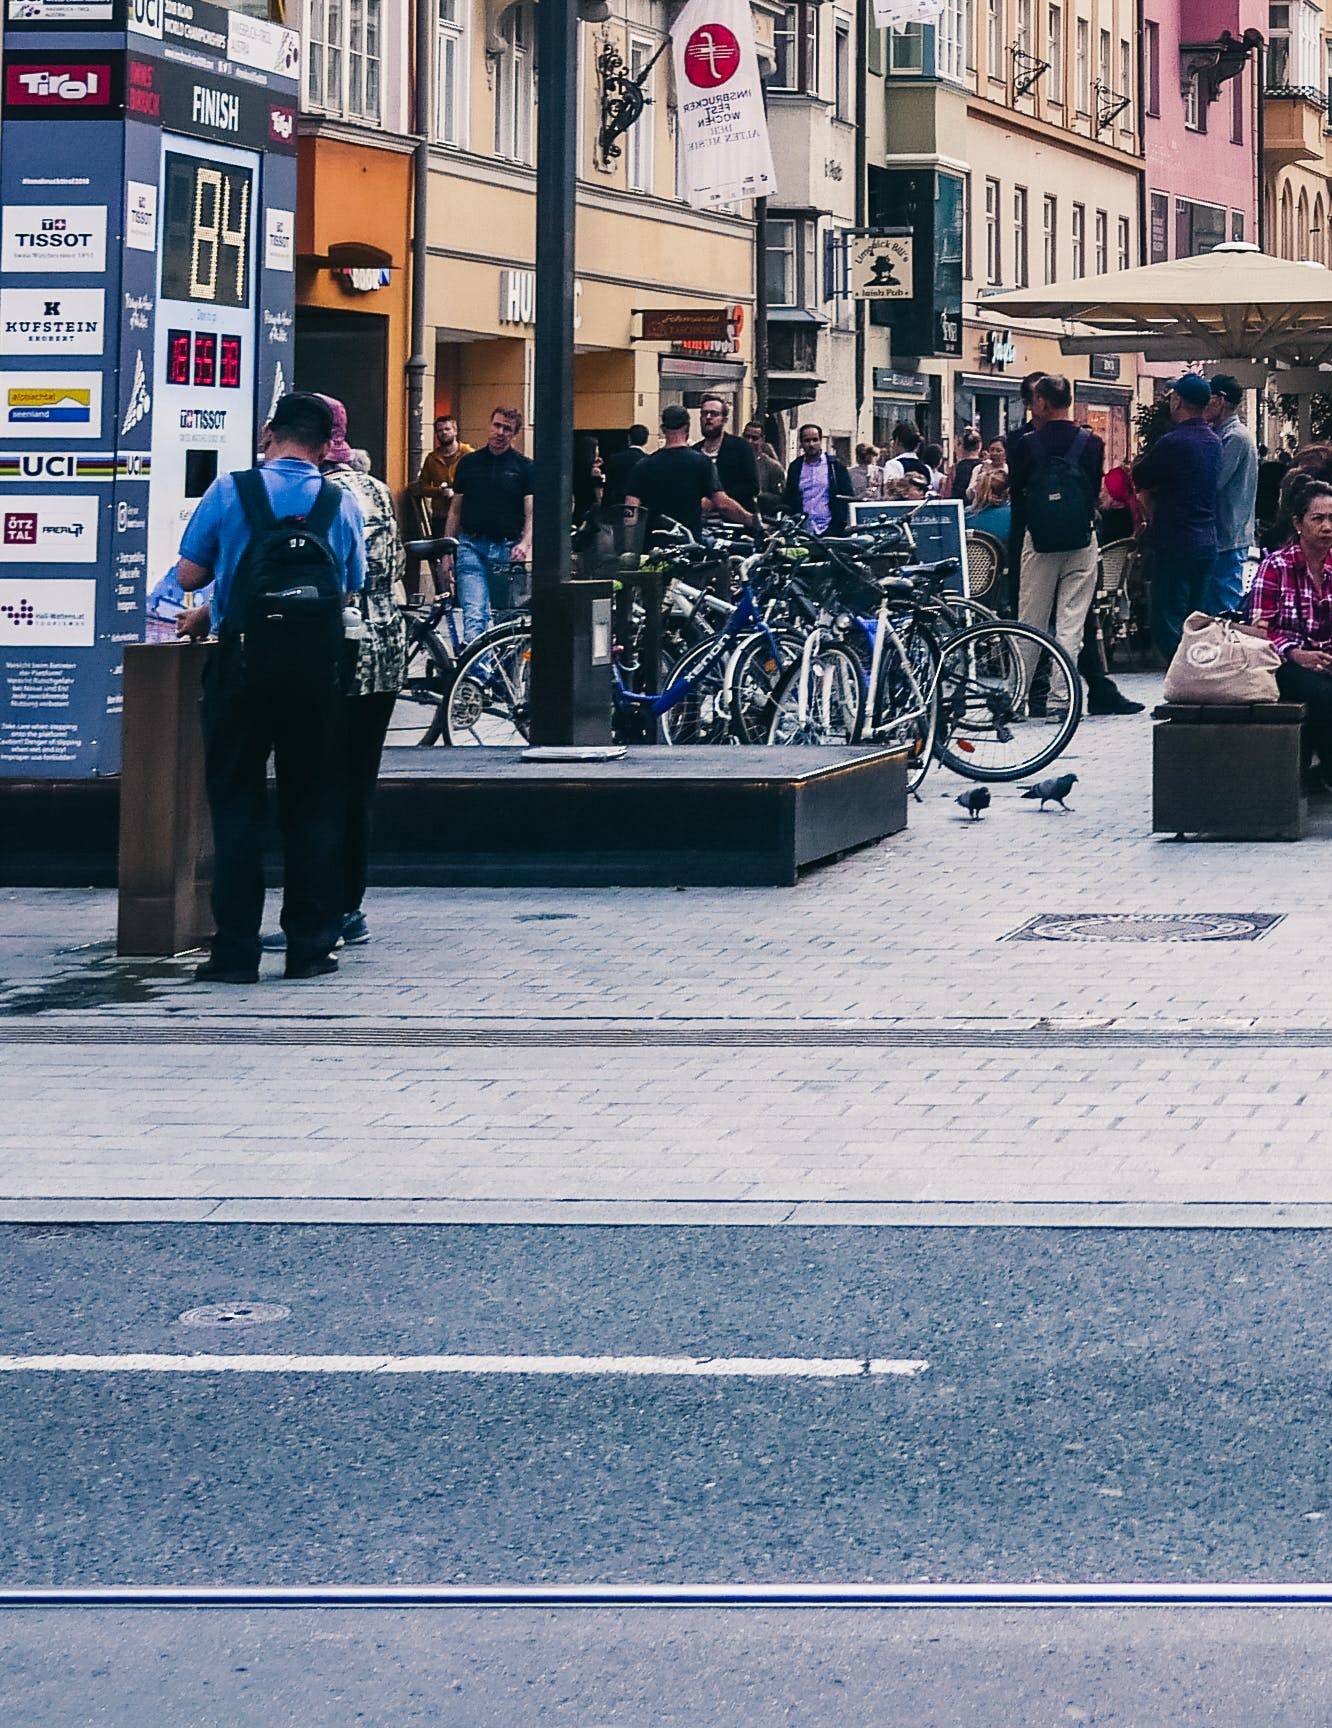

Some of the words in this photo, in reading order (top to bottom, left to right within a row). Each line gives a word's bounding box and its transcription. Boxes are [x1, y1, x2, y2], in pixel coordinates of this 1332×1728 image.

[19, 72, 98, 100] Tirol
[192, 85, 240, 132] FINISH
[15, 234, 93, 247] TISSOT
[44, 302, 61, 315] K
[5, 322, 98, 332] KUFSTEIN
[194, 409, 227, 430] TISSOT
[23, 456, 74, 477] UCI
[128, 456, 142, 476] UCI
[8, 516, 33, 529] ÖTZ
[8, 532, 33, 540] TAL
